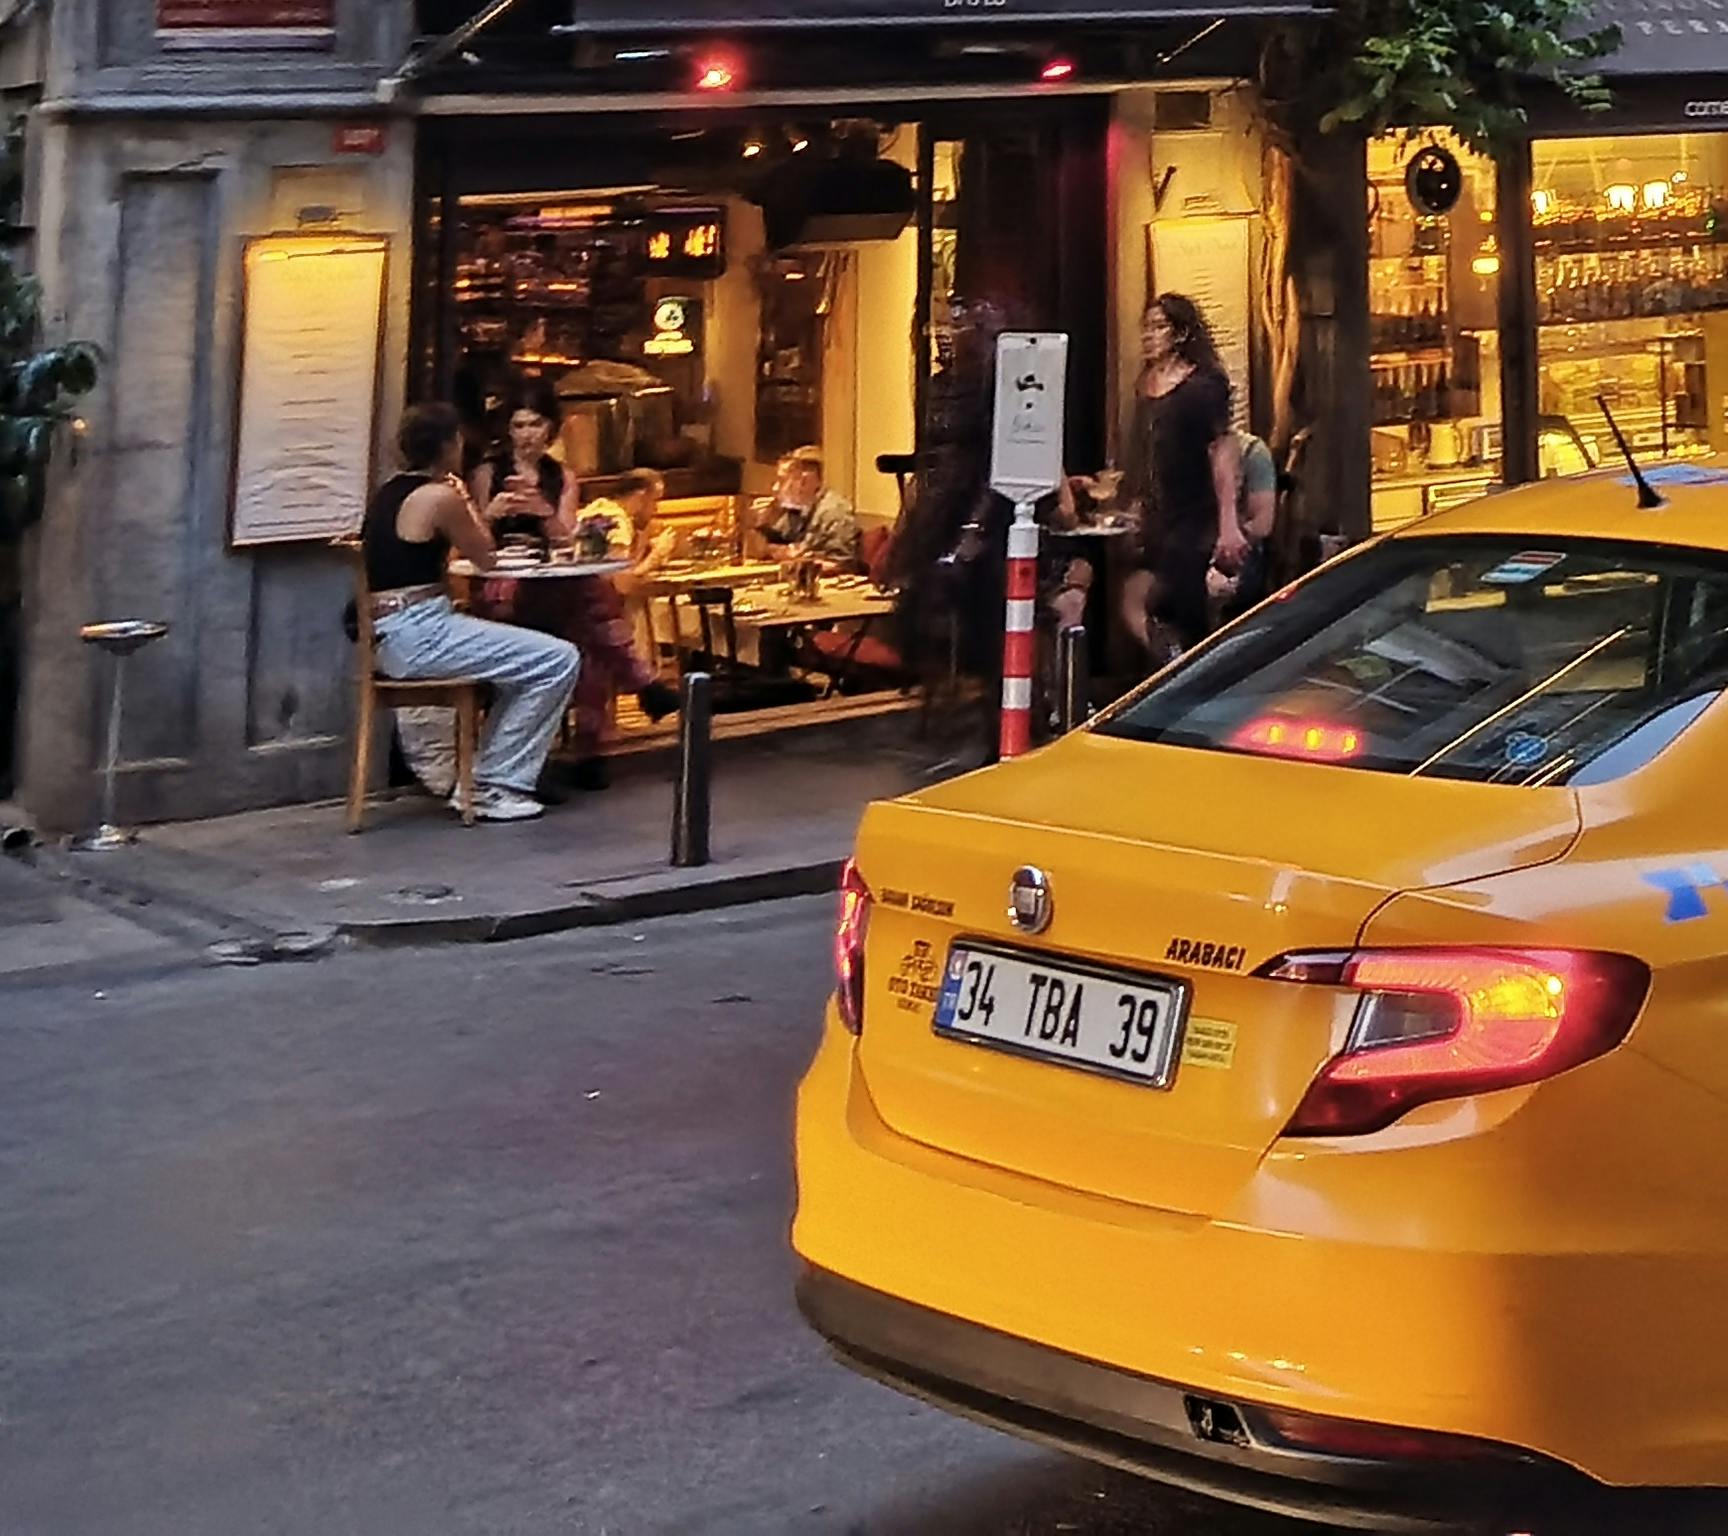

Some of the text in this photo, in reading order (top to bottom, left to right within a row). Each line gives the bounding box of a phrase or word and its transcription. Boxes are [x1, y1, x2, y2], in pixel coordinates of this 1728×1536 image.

[1165, 937, 1247, 971] ARABACI
[957, 959, 996, 1027] 34
[1024, 973, 1084, 1048] TBA
[1109, 993, 1160, 1064] 39
